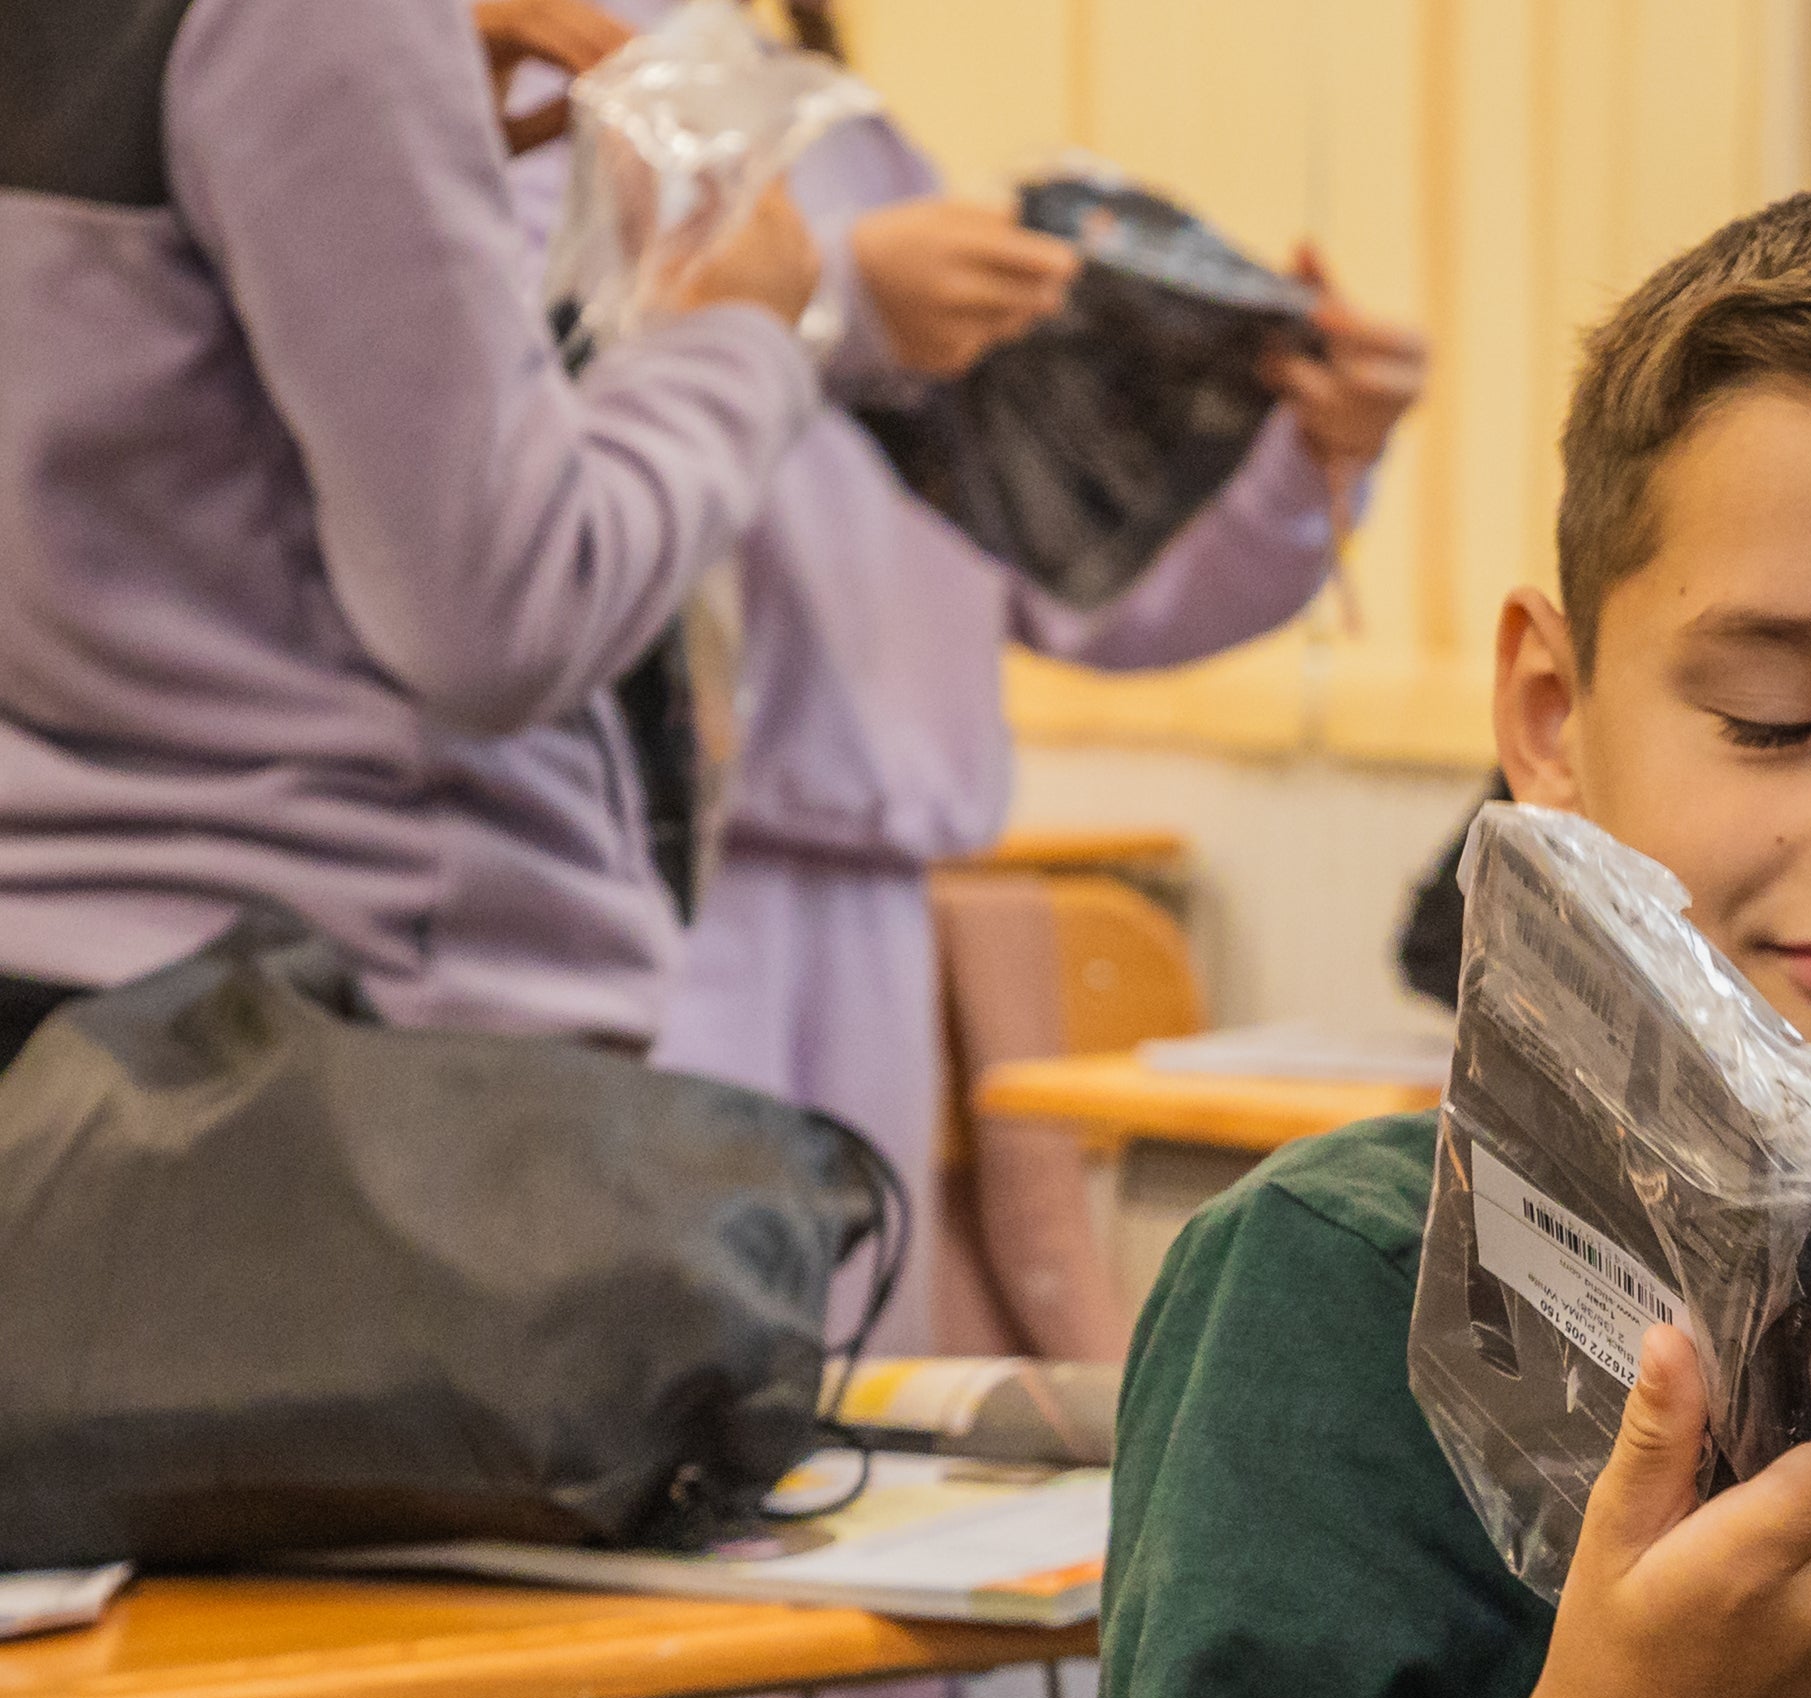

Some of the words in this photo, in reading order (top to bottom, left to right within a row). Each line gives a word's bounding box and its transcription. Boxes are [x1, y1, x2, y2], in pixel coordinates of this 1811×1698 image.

[1560, 1299, 1596, 1333] PUMA
[1565, 1321, 1587, 1346] 005
[1589, 1342, 1636, 1385] 216272
[1606, 1337, 1634, 1365] Black
